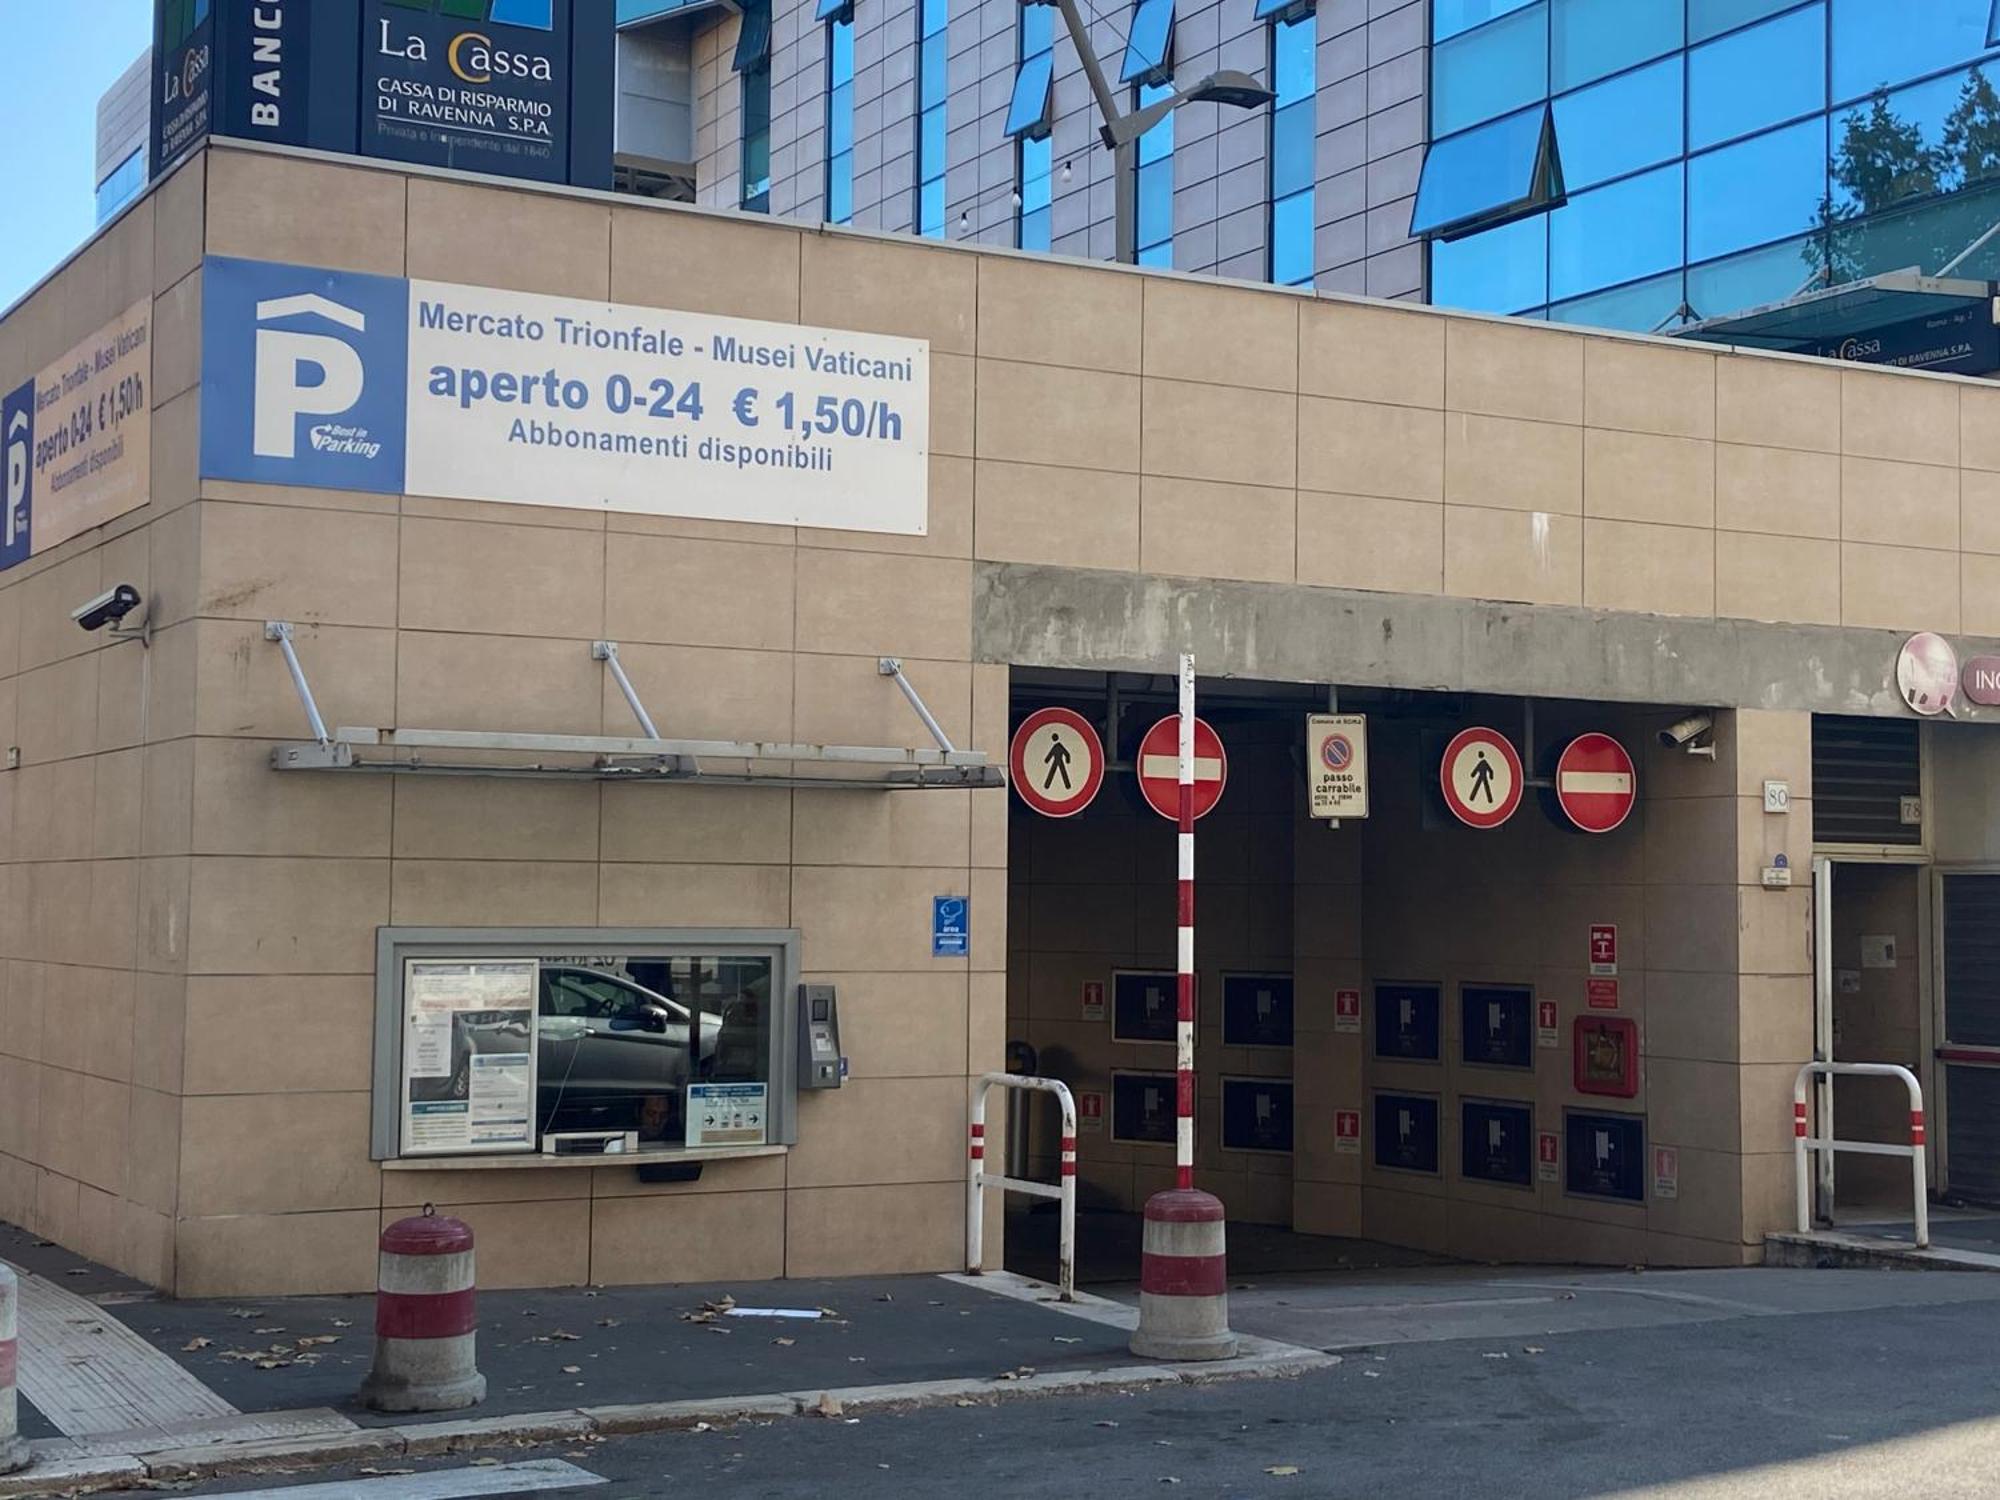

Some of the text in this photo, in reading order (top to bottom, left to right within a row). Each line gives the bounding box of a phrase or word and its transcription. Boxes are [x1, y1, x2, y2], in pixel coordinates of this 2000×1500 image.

[252, 0, 283, 127] BANC
[379, 18, 552, 83] La Cassa
[164, 72, 179, 104] La
[377, 77, 552, 117] CASSA DI RISPARMIO
[378, 96, 397, 112] DI
[408, 100, 495, 127] RAVENNA
[419, 301, 544, 340] Mercato
[554, 317, 683, 356] Trionfale
[712, 335, 795, 368] Musei
[804, 345, 911, 381] Vaticani
[1840, 338, 1881, 359] Cassa
[1908, 348, 1950, 365] RAVENNA
[254, 328, 364, 459] P
[428, 364, 902, 441] aperto 0-24 € 1,50/h
[36, 422, 69, 475] aperto
[71, 400, 92, 449] 0-24
[331, 424, 368, 438] Best in
[508, 418, 832, 471] Abbonamenti disponibili
[316, 436, 382, 459] Parking
[1315, 783, 1362, 793] carrabile
[1323, 773, 1354, 784] passo
[1768, 789, 1788, 806] 80
[1903, 802, 1921, 817] 78
